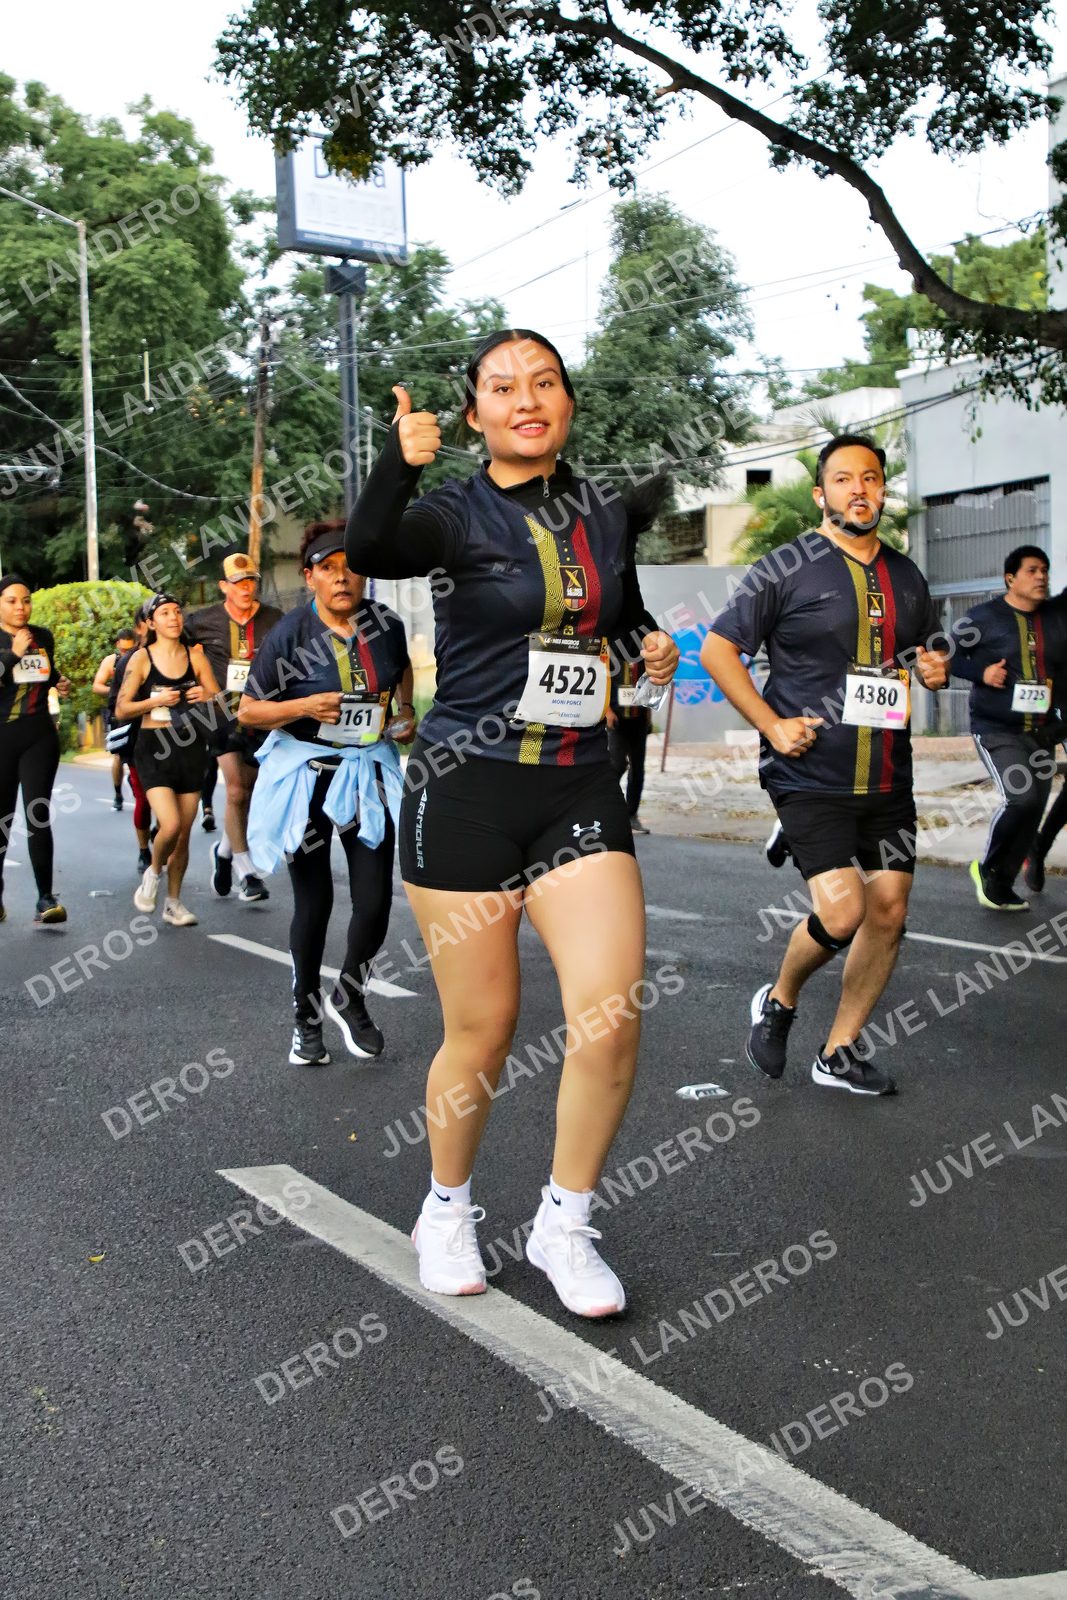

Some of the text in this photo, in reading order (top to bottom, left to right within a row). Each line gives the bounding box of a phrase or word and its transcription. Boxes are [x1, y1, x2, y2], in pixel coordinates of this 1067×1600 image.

[539, 664, 597, 696] 4522
[855, 684, 898, 707] 4380
[1019, 688, 1046, 701] 2725
[415, 787, 428, 869] ARMOUR
